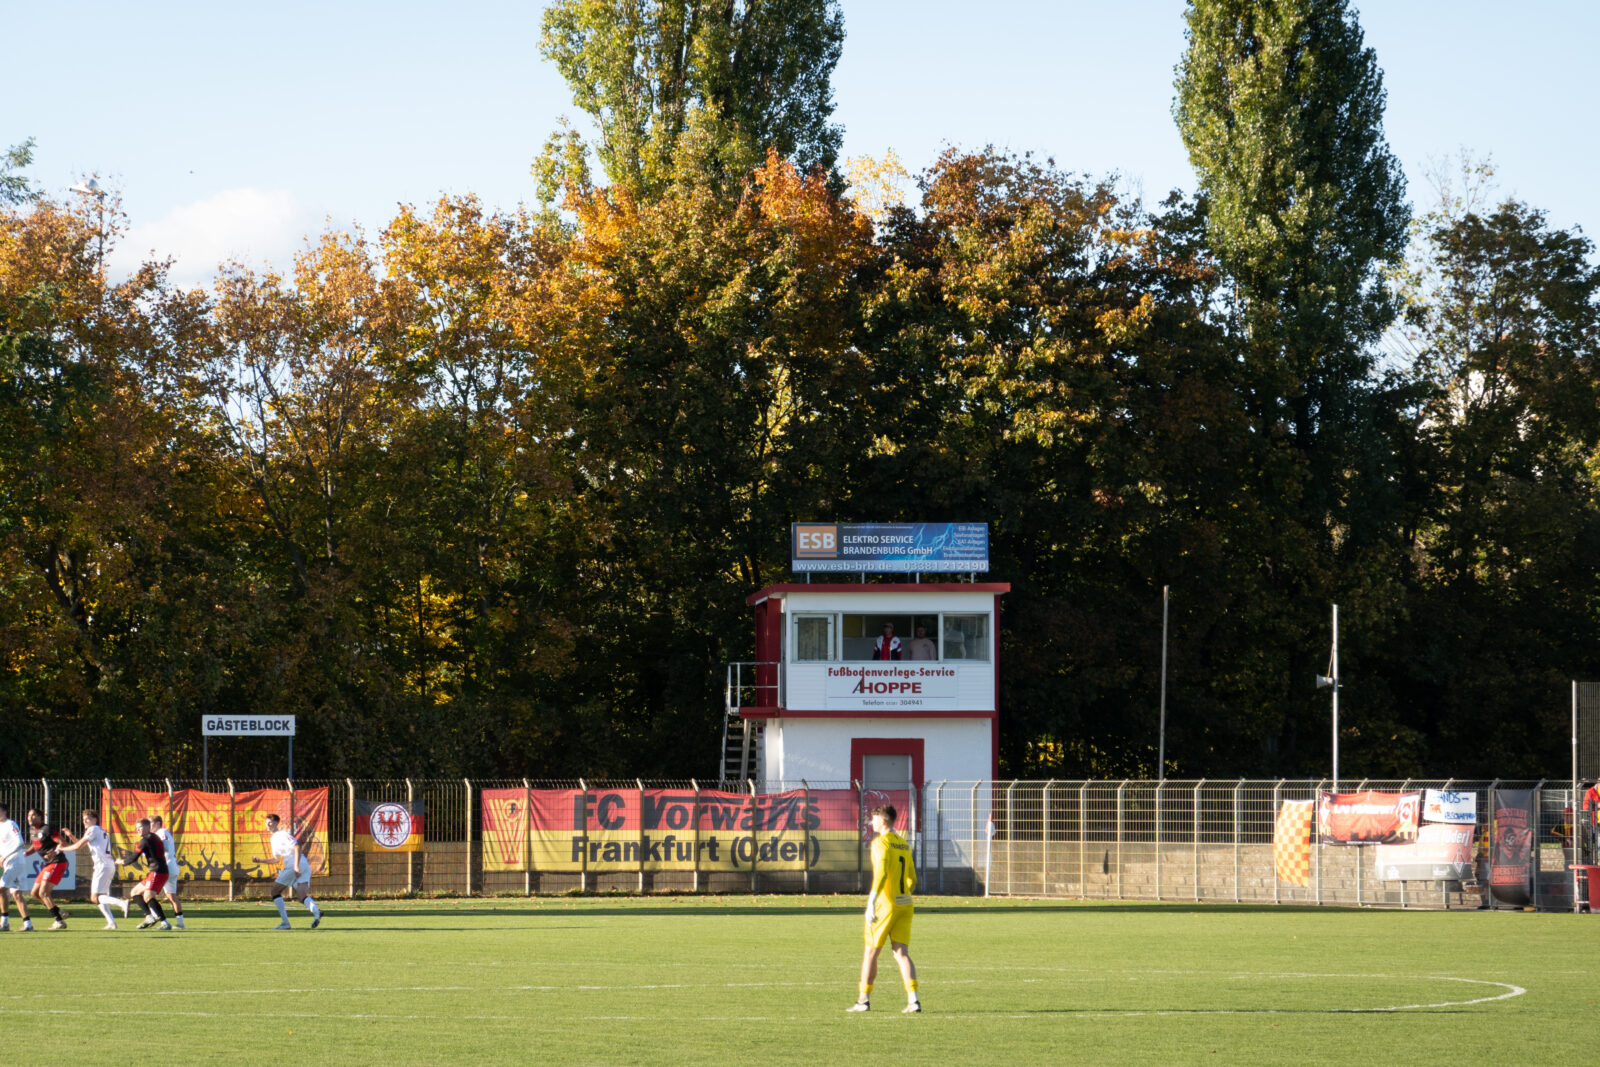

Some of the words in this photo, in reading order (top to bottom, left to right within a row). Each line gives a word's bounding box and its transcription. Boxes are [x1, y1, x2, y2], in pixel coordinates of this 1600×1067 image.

[799, 532, 835, 549] ESB
[843, 535, 879, 544] ELEKTRO
[880, 535, 914, 544] SERVICE
[843, 546, 906, 555] BRANDENBURG
[907, 546, 933, 555] GmbH
[796, 561, 892, 571] www.esb-brb.de
[903, 561, 938, 571] 03381
[943, 561, 986, 571] 212190
[828, 666, 955, 679] Fußbodenverlege-Service
[206, 716, 290, 732] GÄSTEBLOCK
[574, 794, 626, 831] FC
[642, 793, 821, 831] Vorwärts
[572, 835, 720, 863] Frankfurt
[731, 835, 821, 868] (Oder)
[898, 855, 906, 894] 1
